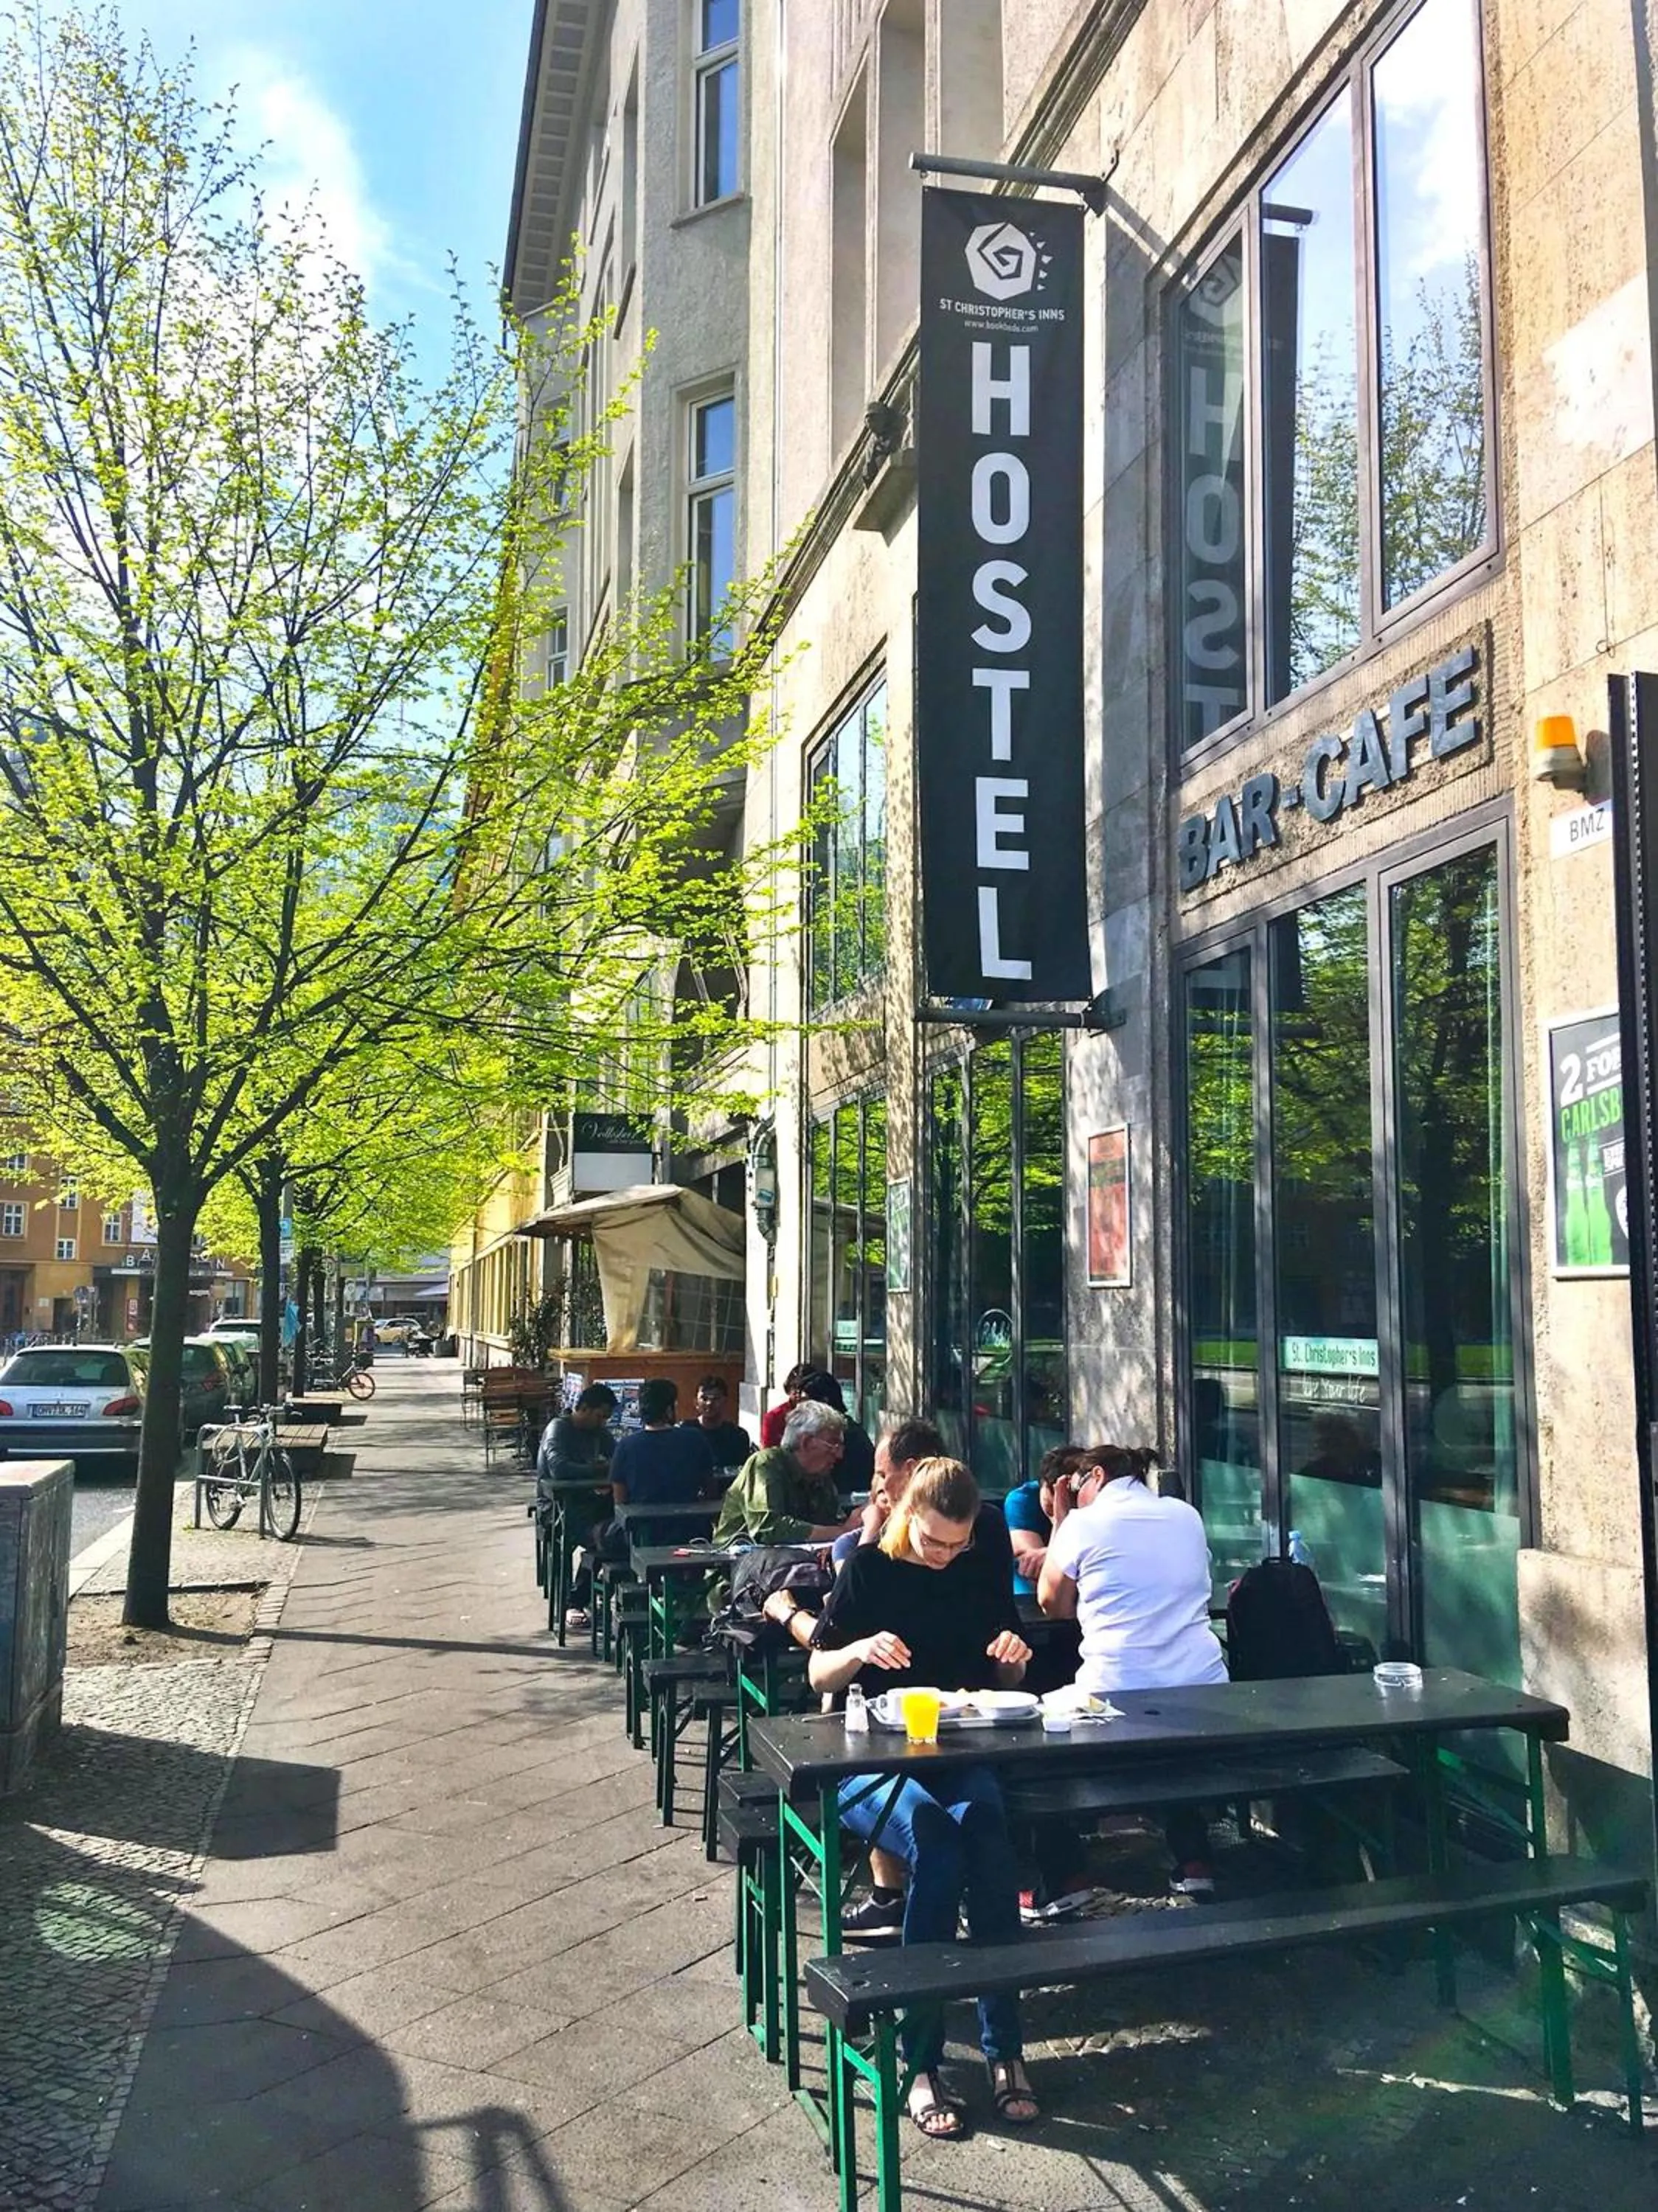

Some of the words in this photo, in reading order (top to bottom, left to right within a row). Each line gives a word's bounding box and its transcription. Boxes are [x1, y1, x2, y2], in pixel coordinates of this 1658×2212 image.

[940, 298, 952, 310] ST
[954, 301, 1036, 321] CHRISTOPHER'S
[1038, 309, 1065, 321] INNS
[971, 341, 1032, 980] HOSTEL
[1179, 644, 1476, 891] BAR-CAFE
[1569, 807, 1604, 842] BMZ
[1560, 1052, 1584, 1109] 2
